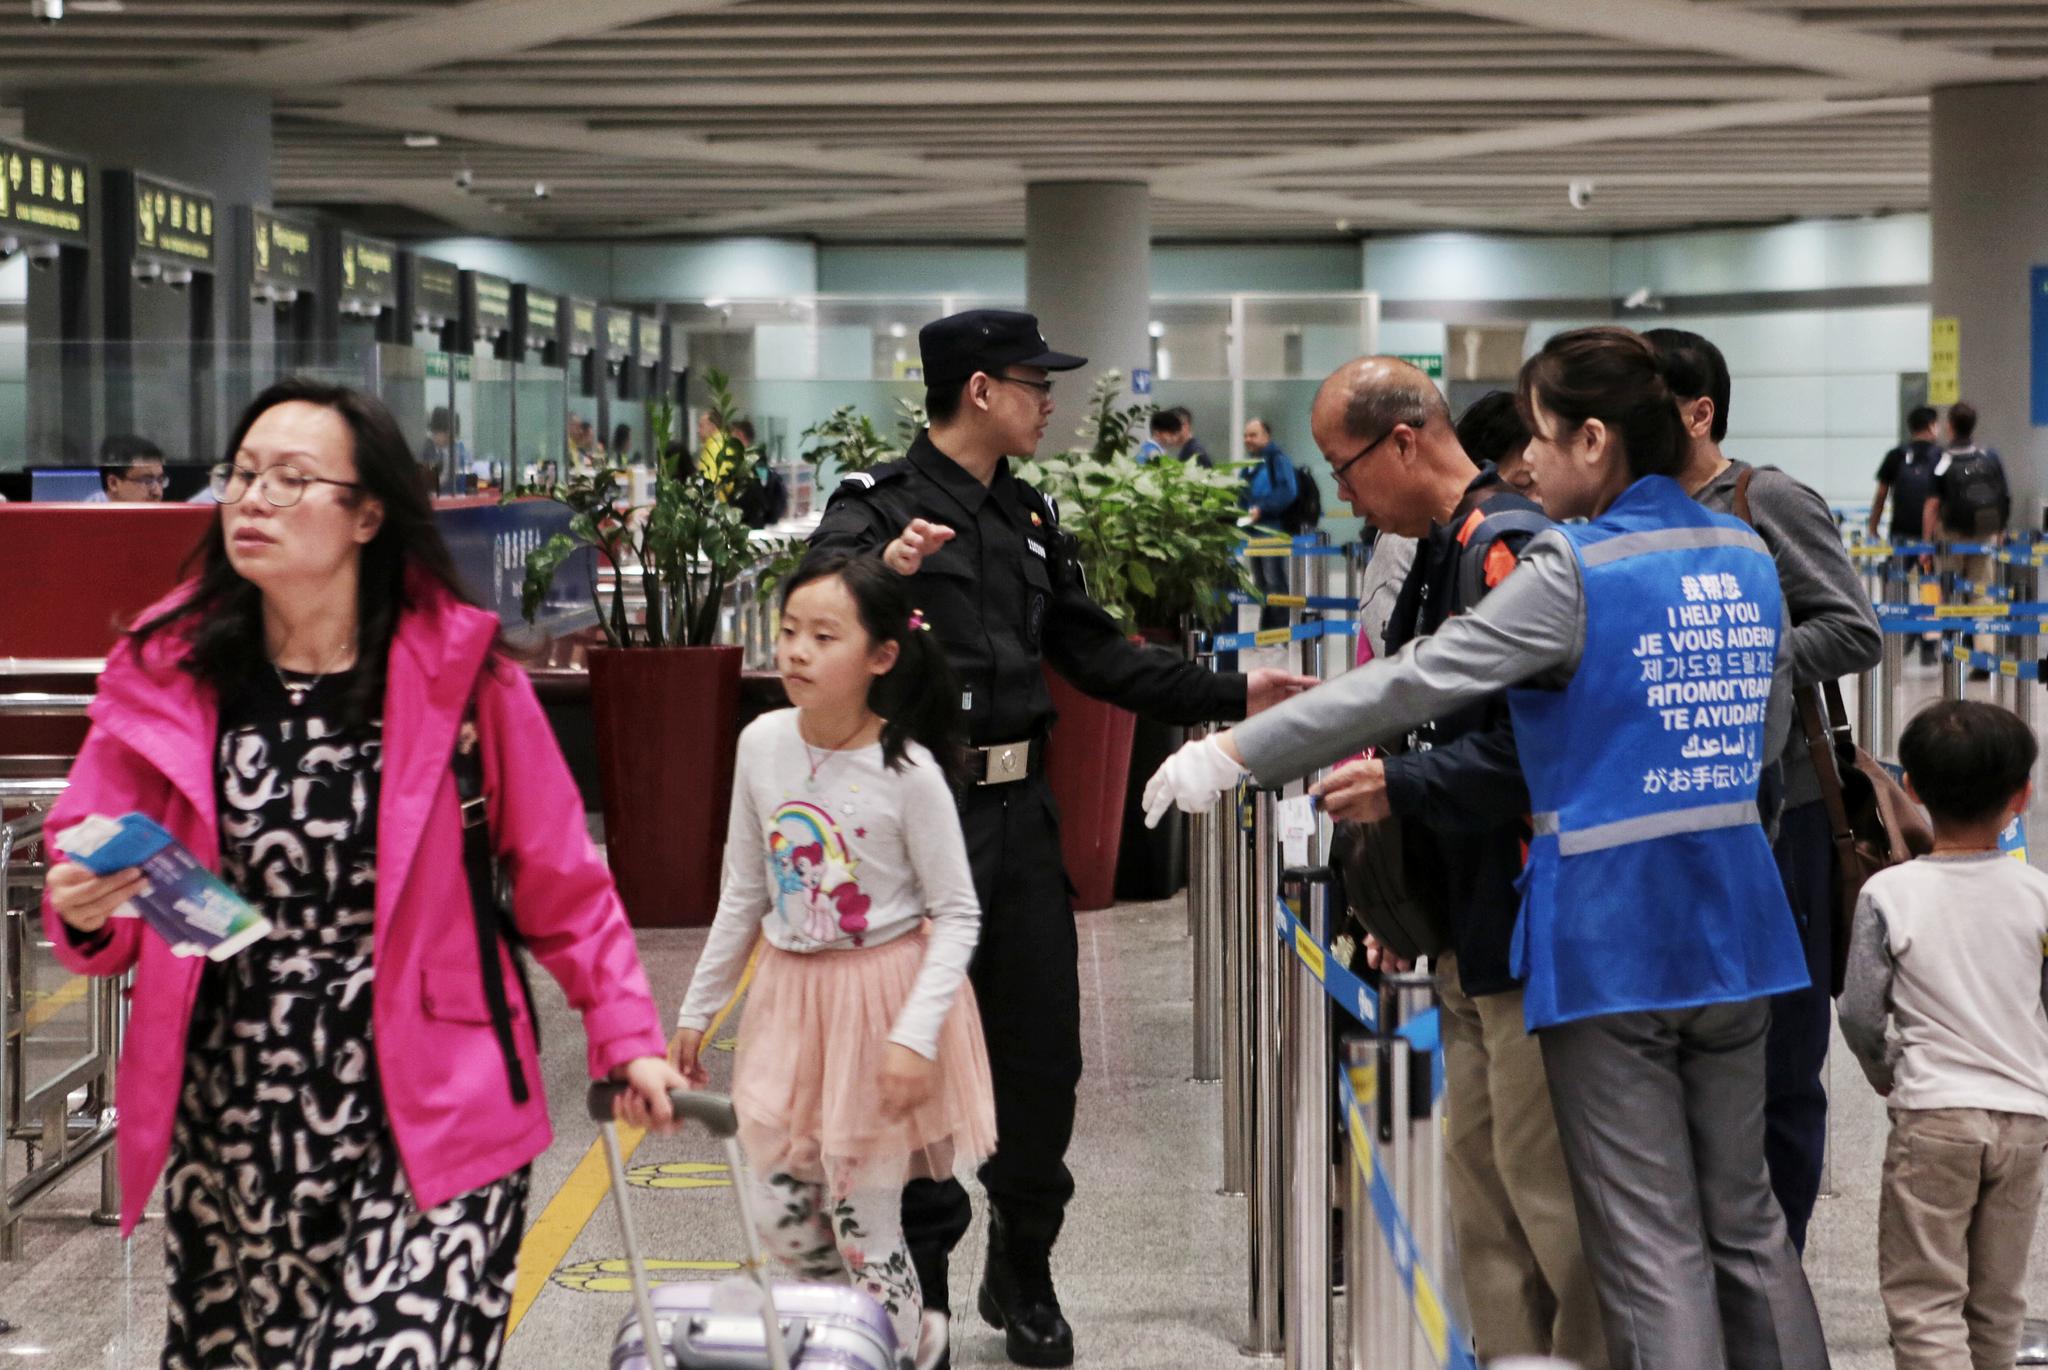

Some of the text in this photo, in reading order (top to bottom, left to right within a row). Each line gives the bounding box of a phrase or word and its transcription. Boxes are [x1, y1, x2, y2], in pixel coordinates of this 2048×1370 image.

[1667, 602, 1760, 628] I HELP YOU
[1632, 633, 1664, 657] JE
[1668, 628, 1724, 653] VOUS
[1660, 708, 1689, 731] TE
